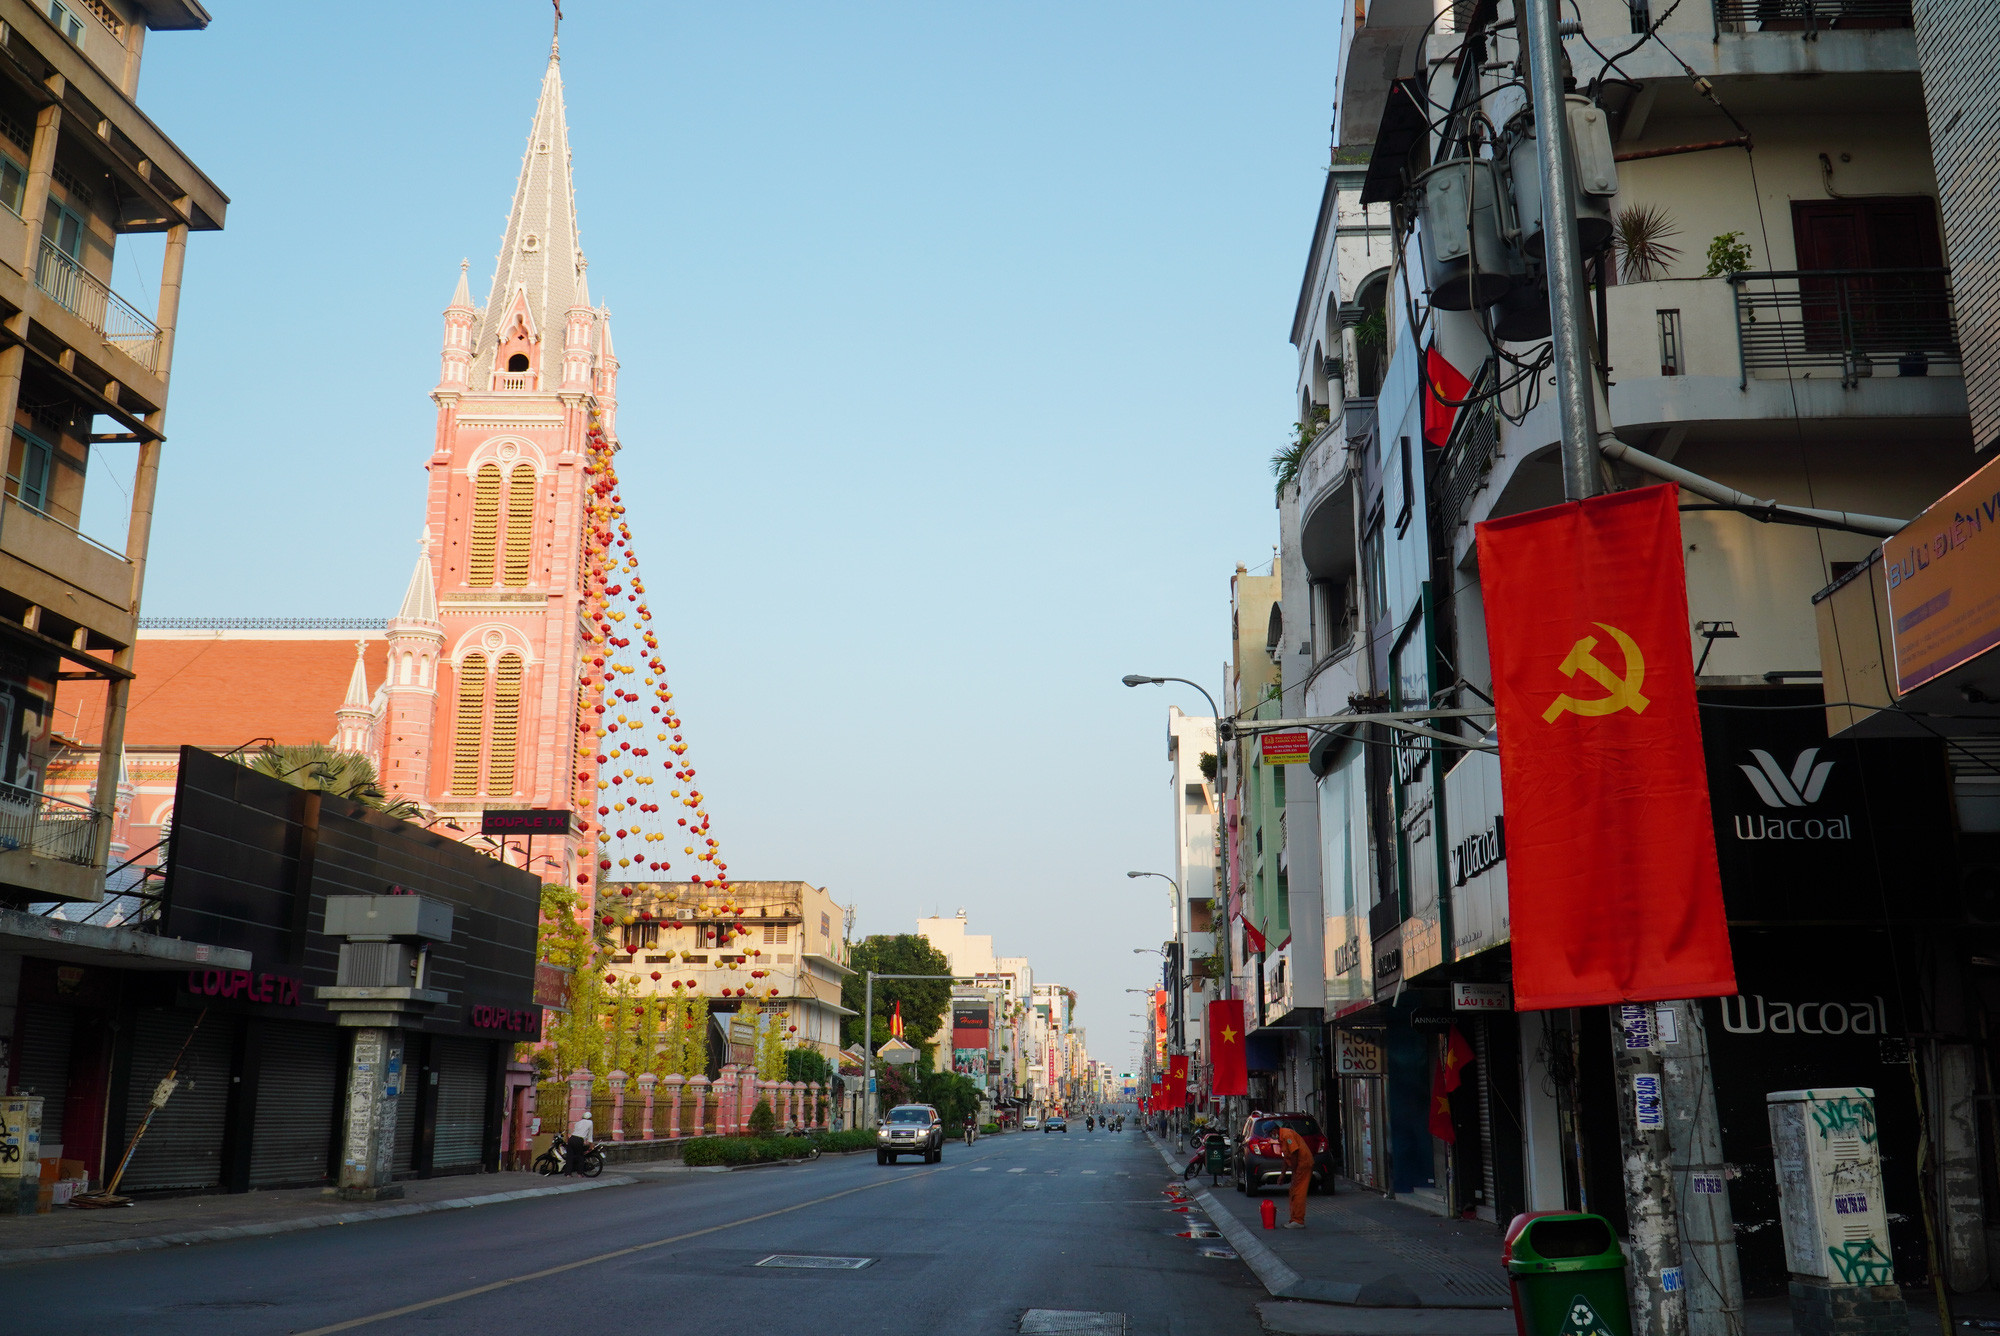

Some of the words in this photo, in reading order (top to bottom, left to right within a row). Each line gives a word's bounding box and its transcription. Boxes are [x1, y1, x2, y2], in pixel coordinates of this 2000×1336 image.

[1934, 507, 1982, 560] ĐIỆN
[1983, 490, 2000, 523] V
[485, 817, 543, 828] COUPLE
[547, 817, 565, 827] TX
[1734, 814, 1851, 840] Wacoal
[1463, 815, 1499, 878] Wacoal
[188, 969, 275, 1004] COUPLE
[277, 975, 303, 1007] TX
[1480, 998, 1485, 1006] 1
[1487, 998, 1494, 1006] &
[1496, 998, 1503, 1006] 2
[1720, 995, 1887, 1035] Wacoal
[473, 1004, 521, 1032] COUPLE
[524, 1010, 538, 1033] TX
[1414, 1016, 1457, 1024] ANNACOCO
[1622, 1004, 1650, 1048] 976.562.599
[1342, 1033, 1376, 1045] HOA
[1343, 1046, 1376, 1057] ANH
